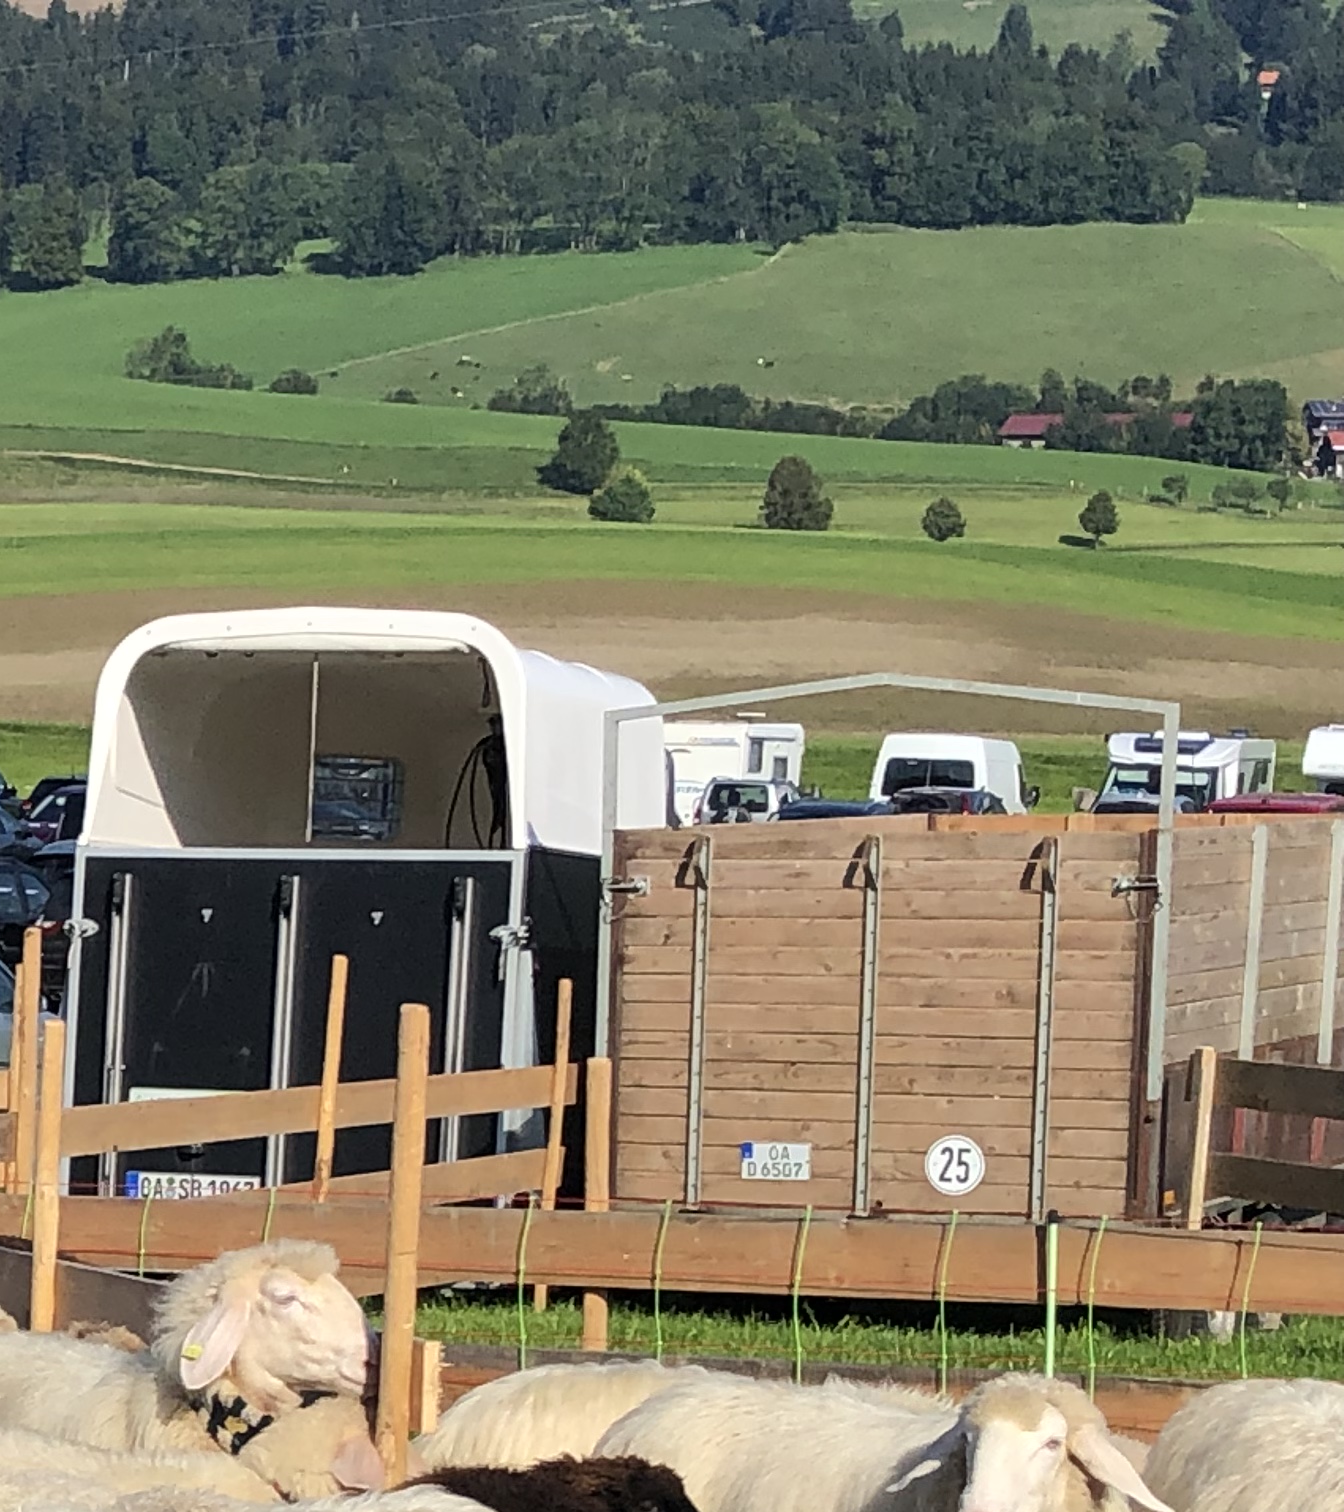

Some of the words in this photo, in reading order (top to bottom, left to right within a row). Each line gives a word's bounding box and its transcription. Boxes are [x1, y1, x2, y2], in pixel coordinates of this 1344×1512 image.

[768, 1144, 790, 1161] OA
[747, 1161, 757, 1177] D
[761, 1161, 803, 1178] 6507
[938, 1146, 972, 1184] 25
